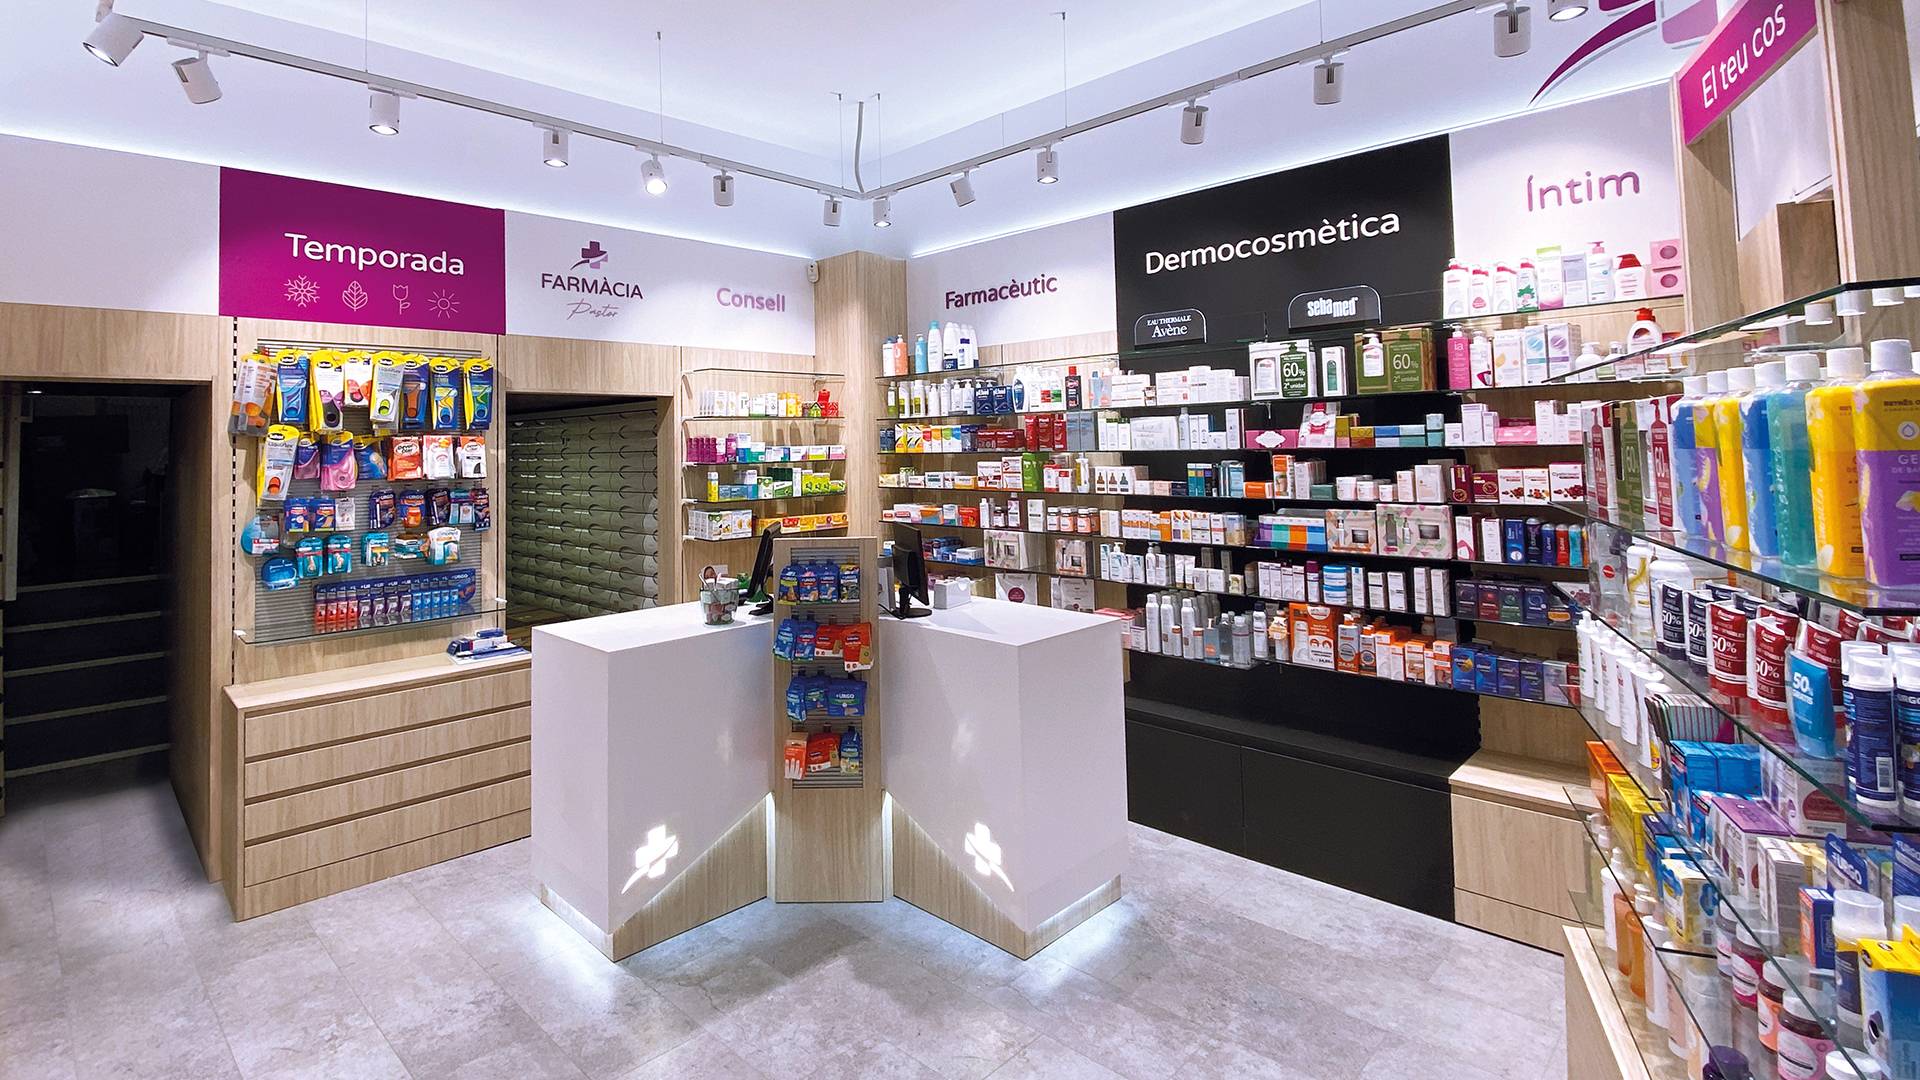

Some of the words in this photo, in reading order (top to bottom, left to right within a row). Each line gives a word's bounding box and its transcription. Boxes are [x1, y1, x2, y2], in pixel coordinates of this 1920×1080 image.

[1700, 71, 1718, 109] El
[1719, 51, 1749, 89] teu
[1752, 3, 1786, 58] cos
[1526, 170, 1641, 212] Íntim
[284, 232, 465, 276] Temporada
[1145, 211, 1401, 275] Dermocosmètica
[541, 272, 644, 300] FARMÀCIA
[715, 287, 786, 313] Consell
[945, 273, 1058, 310] Farmacèutic
[1151, 324, 1188, 338] Avène
[1283, 362, 1306, 377] 60%
[1393, 353, 1419, 370] 60%
